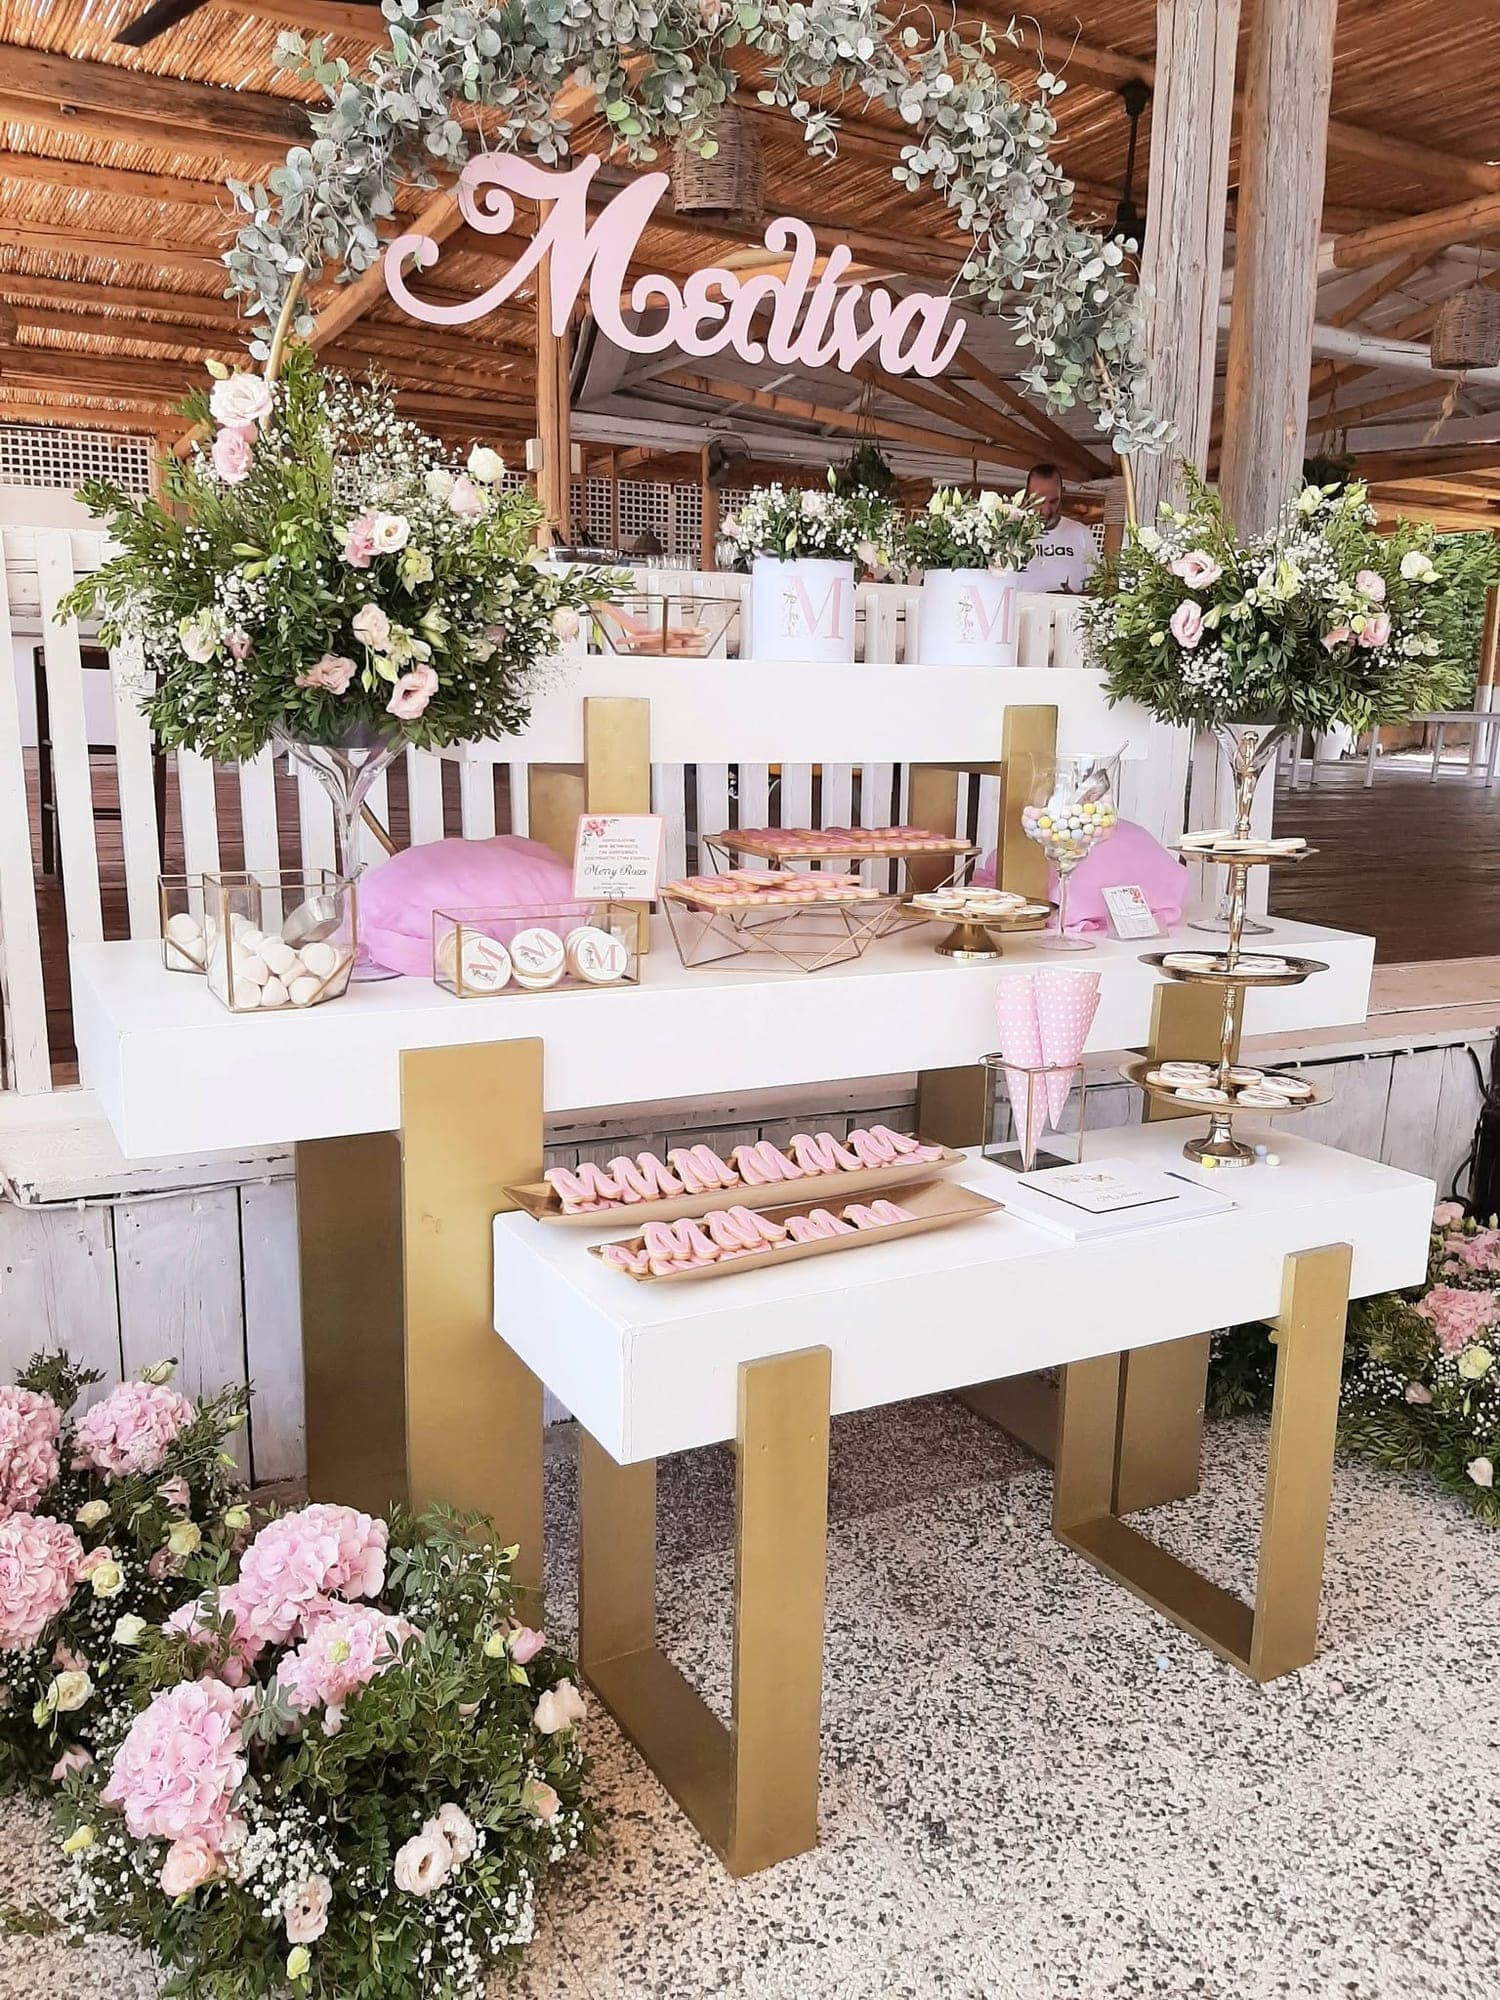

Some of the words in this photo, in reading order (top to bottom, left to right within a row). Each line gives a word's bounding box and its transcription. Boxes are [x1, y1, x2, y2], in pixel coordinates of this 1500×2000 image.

[384, 152, 967, 378] Mediva
[1035, 544, 1074, 557] idas
[782, 575, 847, 641] M
[959, 585, 1015, 645] M
[584, 863, 617, 880] Merry
[584, 940, 621, 972] M
